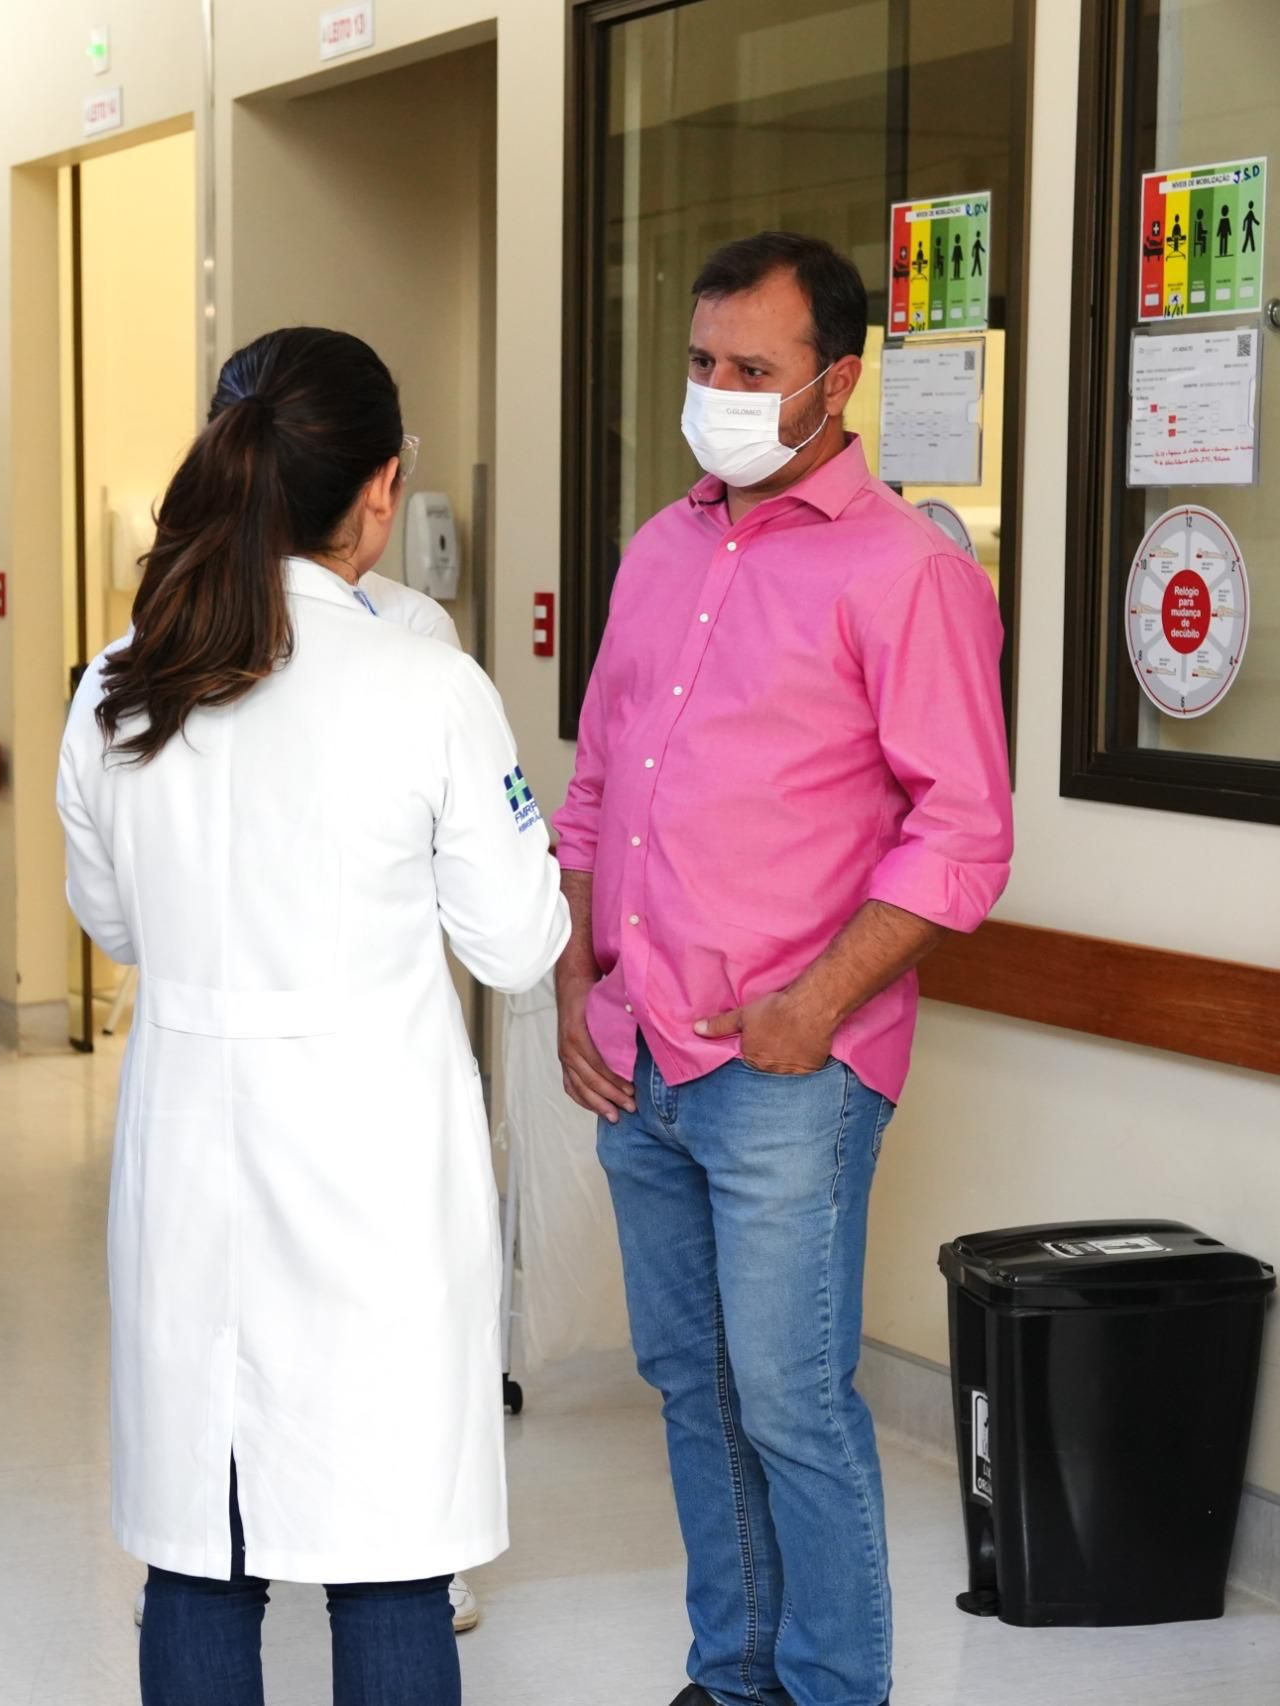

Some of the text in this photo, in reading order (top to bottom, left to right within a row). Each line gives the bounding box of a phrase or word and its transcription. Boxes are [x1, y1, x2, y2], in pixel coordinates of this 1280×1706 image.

[1186, 516, 1193, 528] 12
[1174, 585, 1199, 598] Relógio
[1179, 599, 1194, 608] para
[1171, 608, 1201, 619] mudança
[1181, 618, 1190, 627] de
[1171, 628, 1200, 638] decúbito
